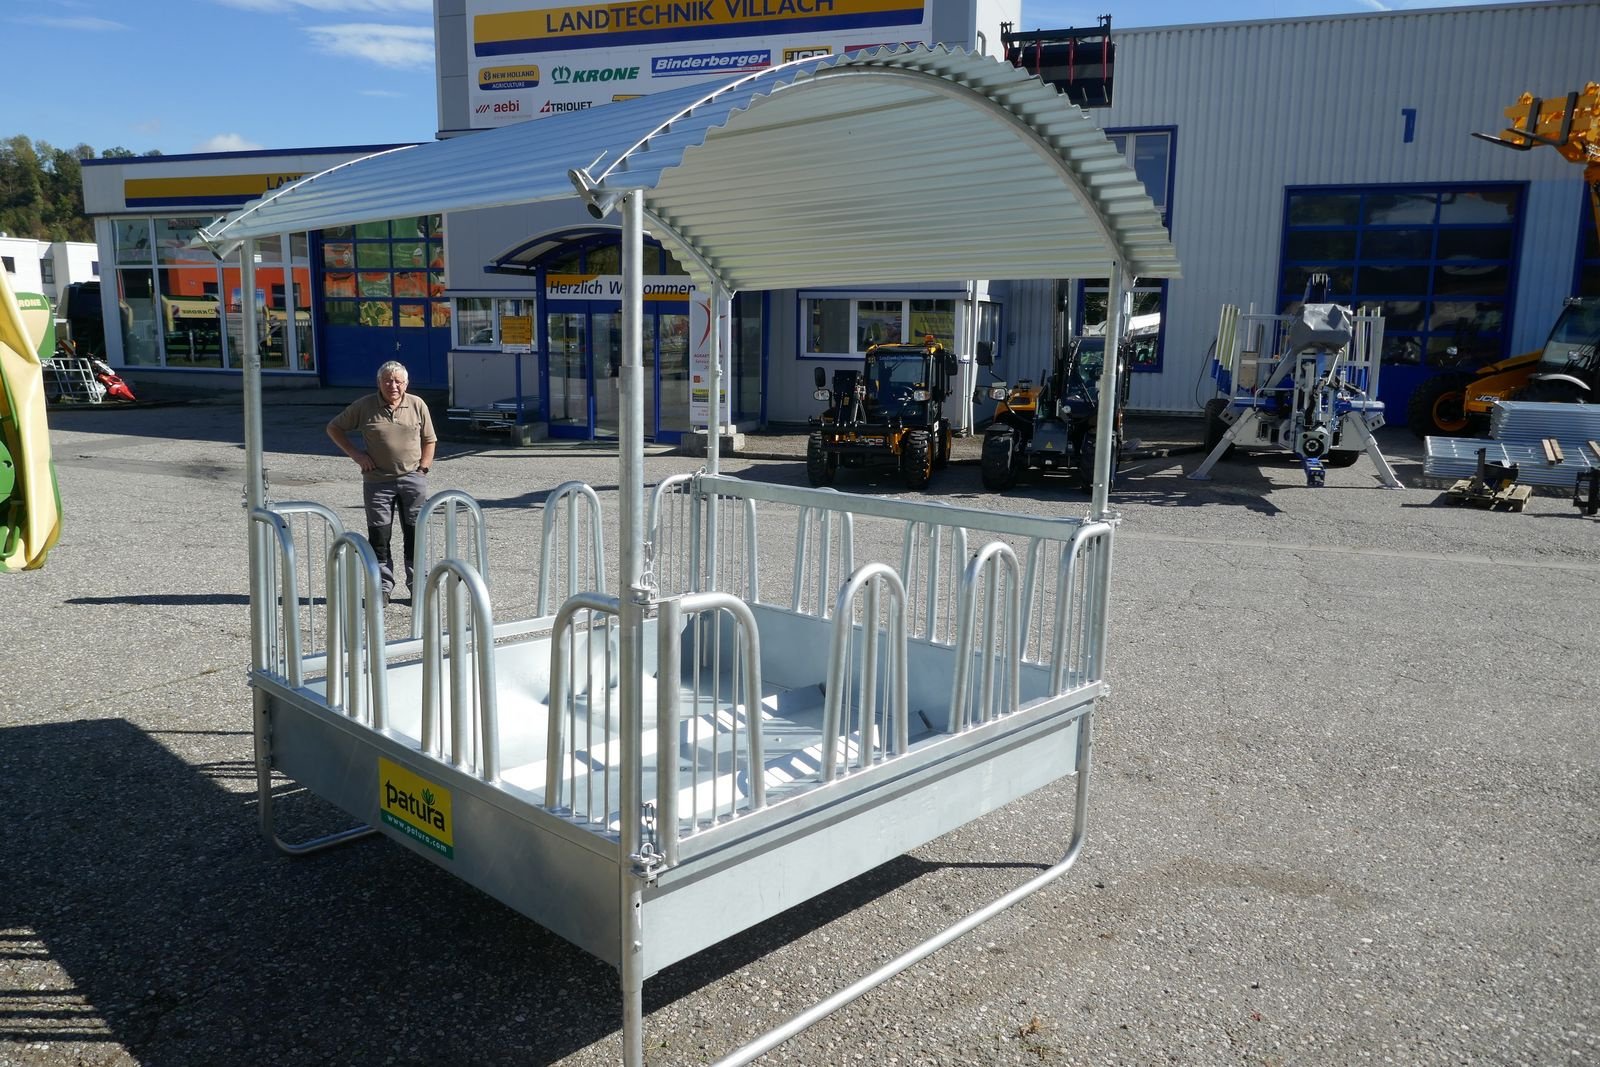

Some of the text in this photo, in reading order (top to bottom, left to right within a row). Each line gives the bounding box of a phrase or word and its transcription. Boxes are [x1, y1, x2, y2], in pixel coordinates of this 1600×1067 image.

[546, 0, 834, 33] LANDTECHNIK VILLACH
[655, 53, 768, 70] Binderberger
[492, 70, 535, 80] NEW HOLLAND
[572, 66, 641, 83] KRONE
[491, 81, 525, 90] AGRICULTURE
[493, 99, 520, 113] aebi
[1402, 108, 1417, 143] 1
[550, 280, 696, 295] Herzlich Wommen
[17, 299, 42, 308] RONE
[385, 779, 446, 832] patura
[387, 814, 447, 853] www.patura.com
